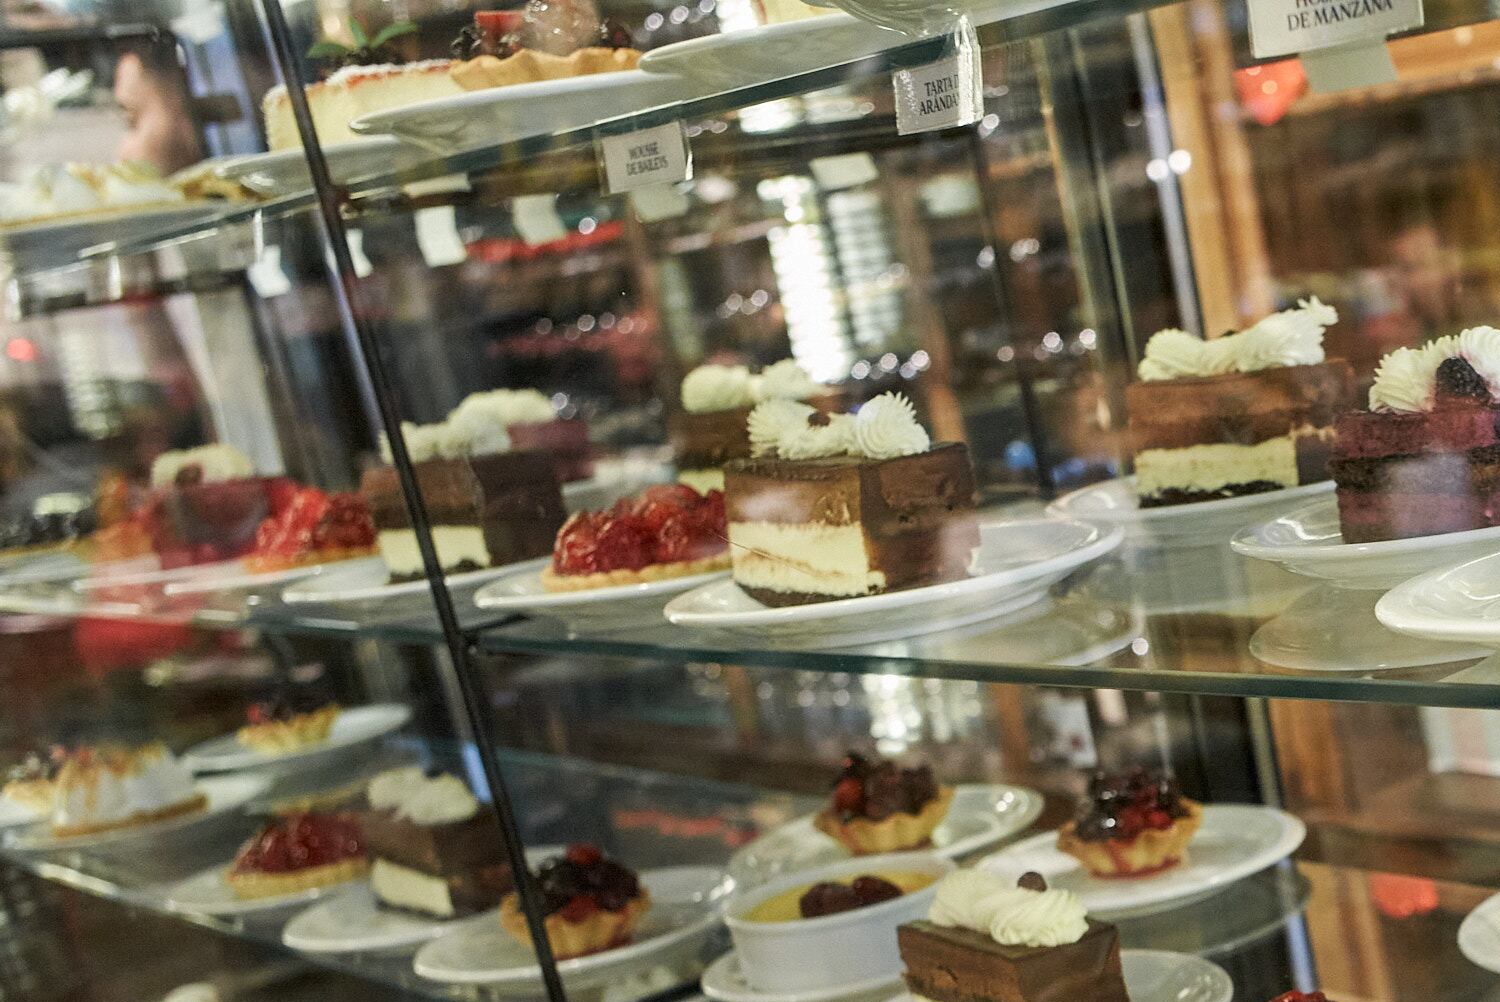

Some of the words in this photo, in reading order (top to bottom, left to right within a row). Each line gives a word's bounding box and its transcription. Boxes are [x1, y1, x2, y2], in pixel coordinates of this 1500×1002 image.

[1287, 13, 1311, 32] DE
[1315, 0, 1393, 26] MANZANA
[924, 76, 953, 97] TARTA
